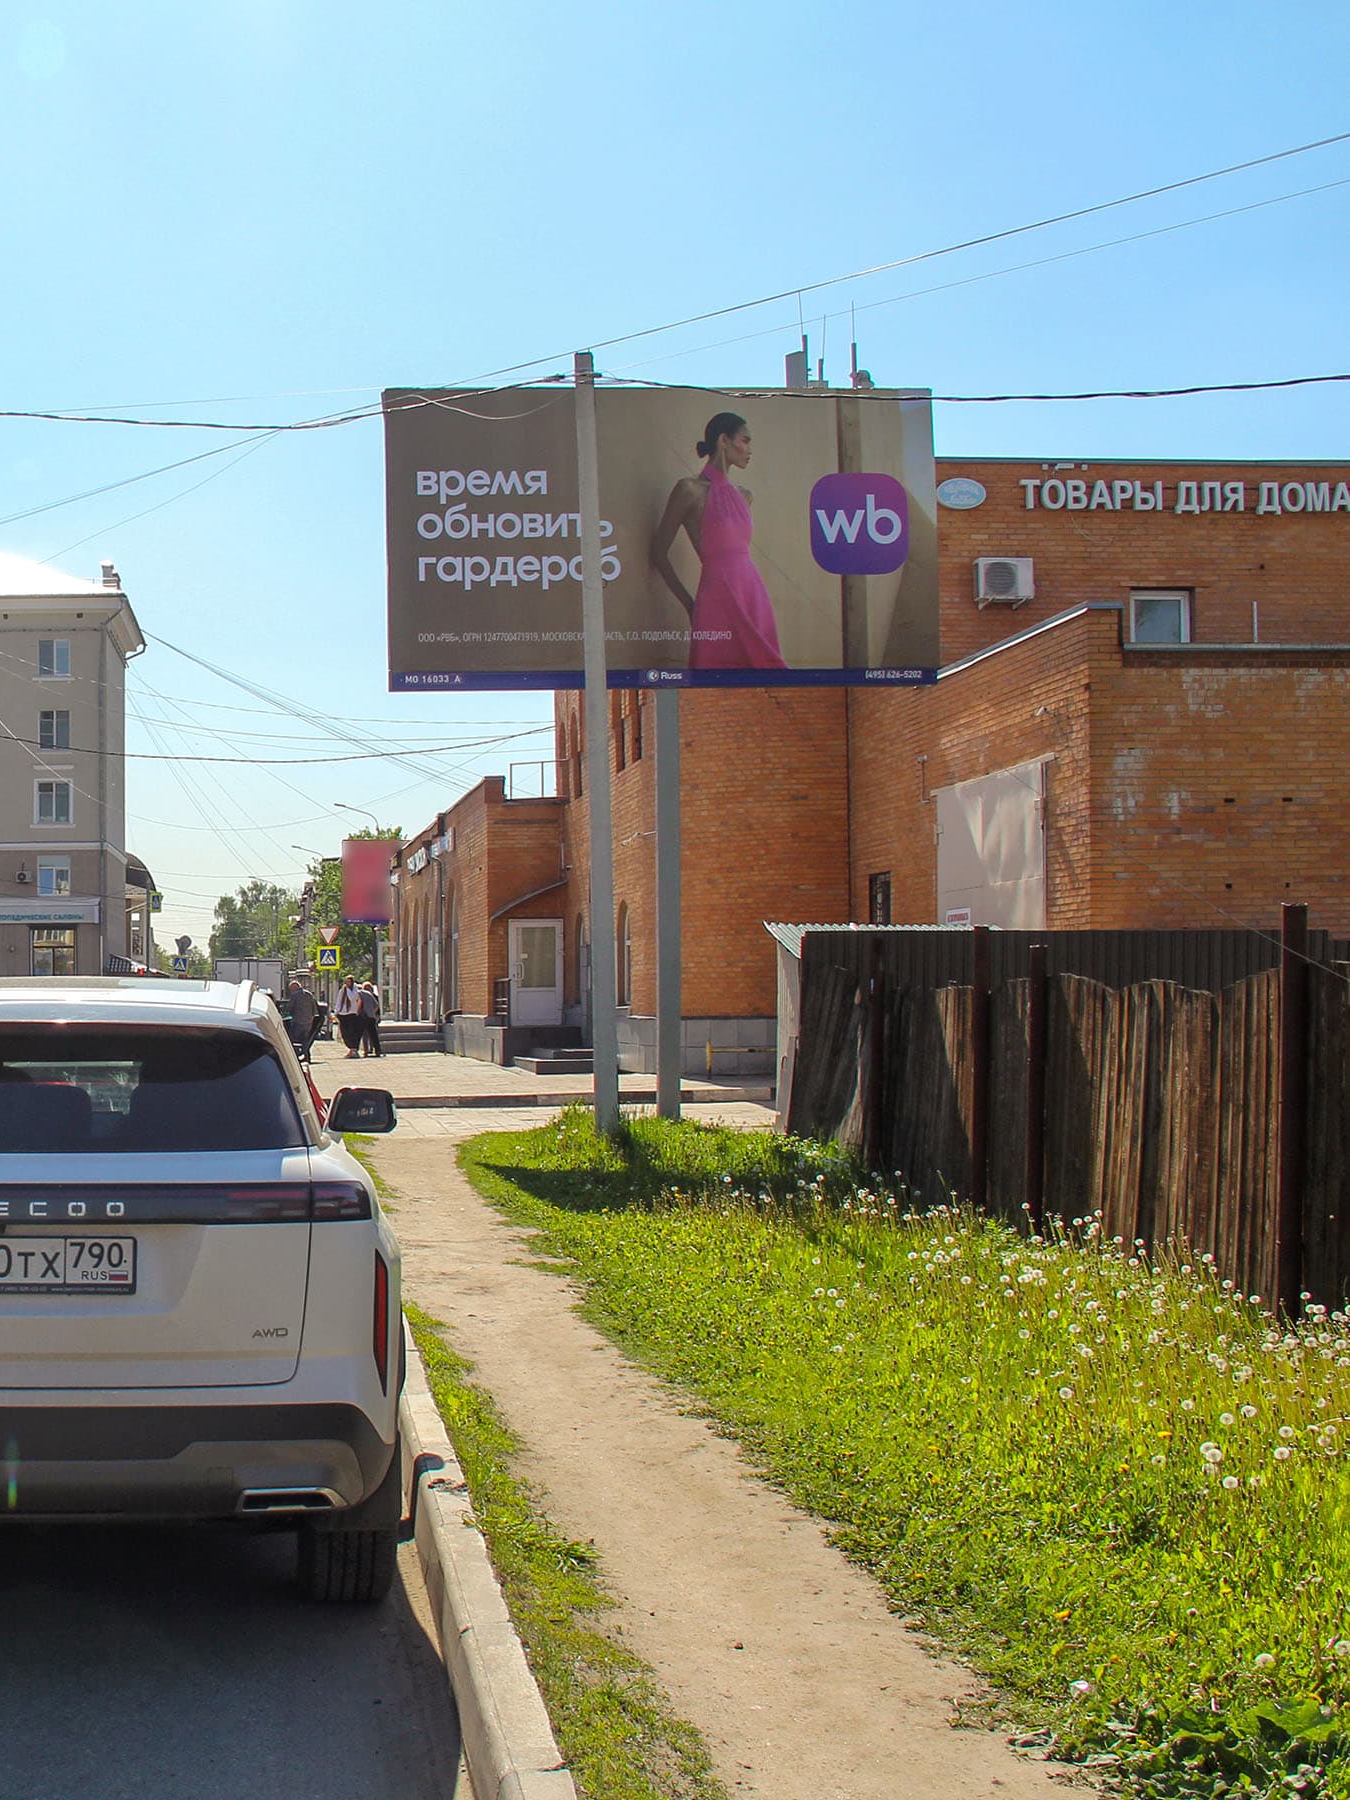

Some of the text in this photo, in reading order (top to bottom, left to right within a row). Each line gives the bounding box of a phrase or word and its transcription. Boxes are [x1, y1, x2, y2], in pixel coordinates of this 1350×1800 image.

[416, 470, 548, 505] время
[1019, 479, 1163, 510] ТОВАРЫ
[1174, 480, 1245, 515] ДЛЯ
[1255, 481, 1350, 516] ДОМА
[815, 494, 902, 545] wb
[418, 632, 435, 643] ООО
[463, 631, 482, 643] ОГРН
[542, 631, 586, 642] МОСКОВСКА
[692, 629, 732, 642] КОЛЕДИНО
[405, 675, 419, 684] МО
[660, 671, 683, 680] Russ
[69, 1241, 124, 1269] 790
[81, 1271, 108, 1281] RUS
[252, 1327, 289, 1338] AWD
